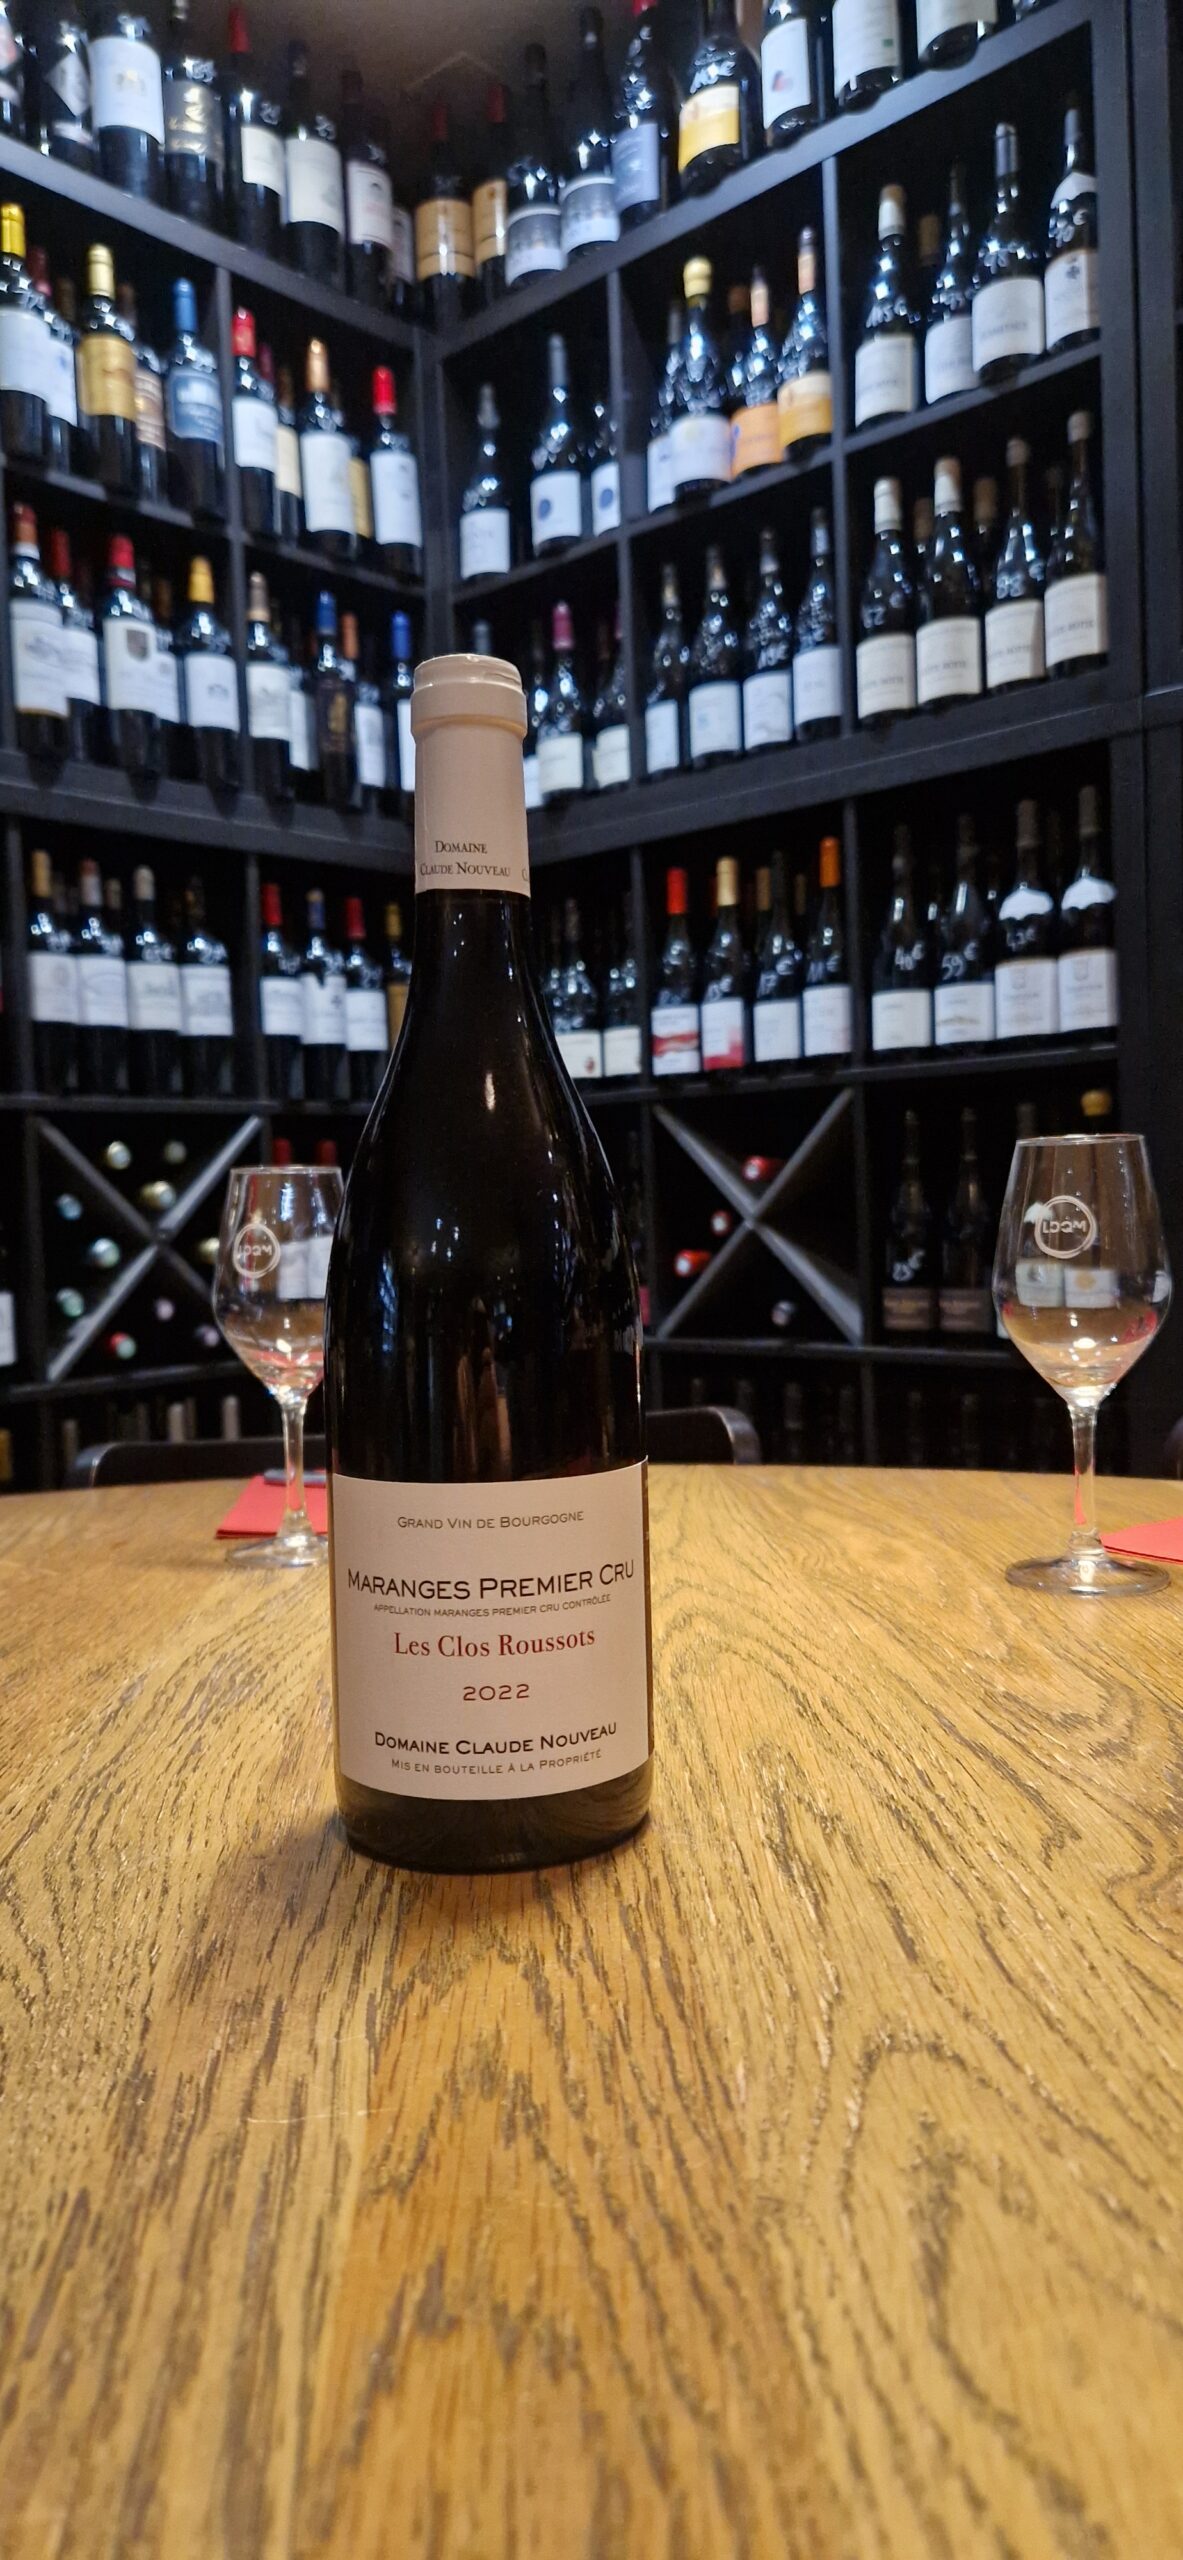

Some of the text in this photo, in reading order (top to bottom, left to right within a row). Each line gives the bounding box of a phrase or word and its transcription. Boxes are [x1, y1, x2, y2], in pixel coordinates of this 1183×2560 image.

[435, 840, 488, 854] DOMAINE
[420, 863, 452, 876] CLAUDE
[456, 862, 510, 877] NOUVEAU
[398, 1511, 584, 1529] GRAND VIN DE BOURGOGNE
[348, 1559, 634, 1600] MARANGES PREMIER CRU
[374, 1594, 611, 1617] APPELLATION MARANGES PREMIER CRU CONTRÔLÉE
[394, 1629, 595, 1657] Les Clos Roussots
[463, 1683, 530, 1701] 2022
[374, 1722, 617, 1755] DOMAINE CLAUDE NOUVEAU
[391, 1758, 411, 1771] MIS
[414, 1762, 430, 1773] EN
[434, 1764, 503, 1774] BOUTEILLE
[520, 1761, 535, 1772] LA
[539, 1749, 602, 1770] PROPRIÉTÉ
